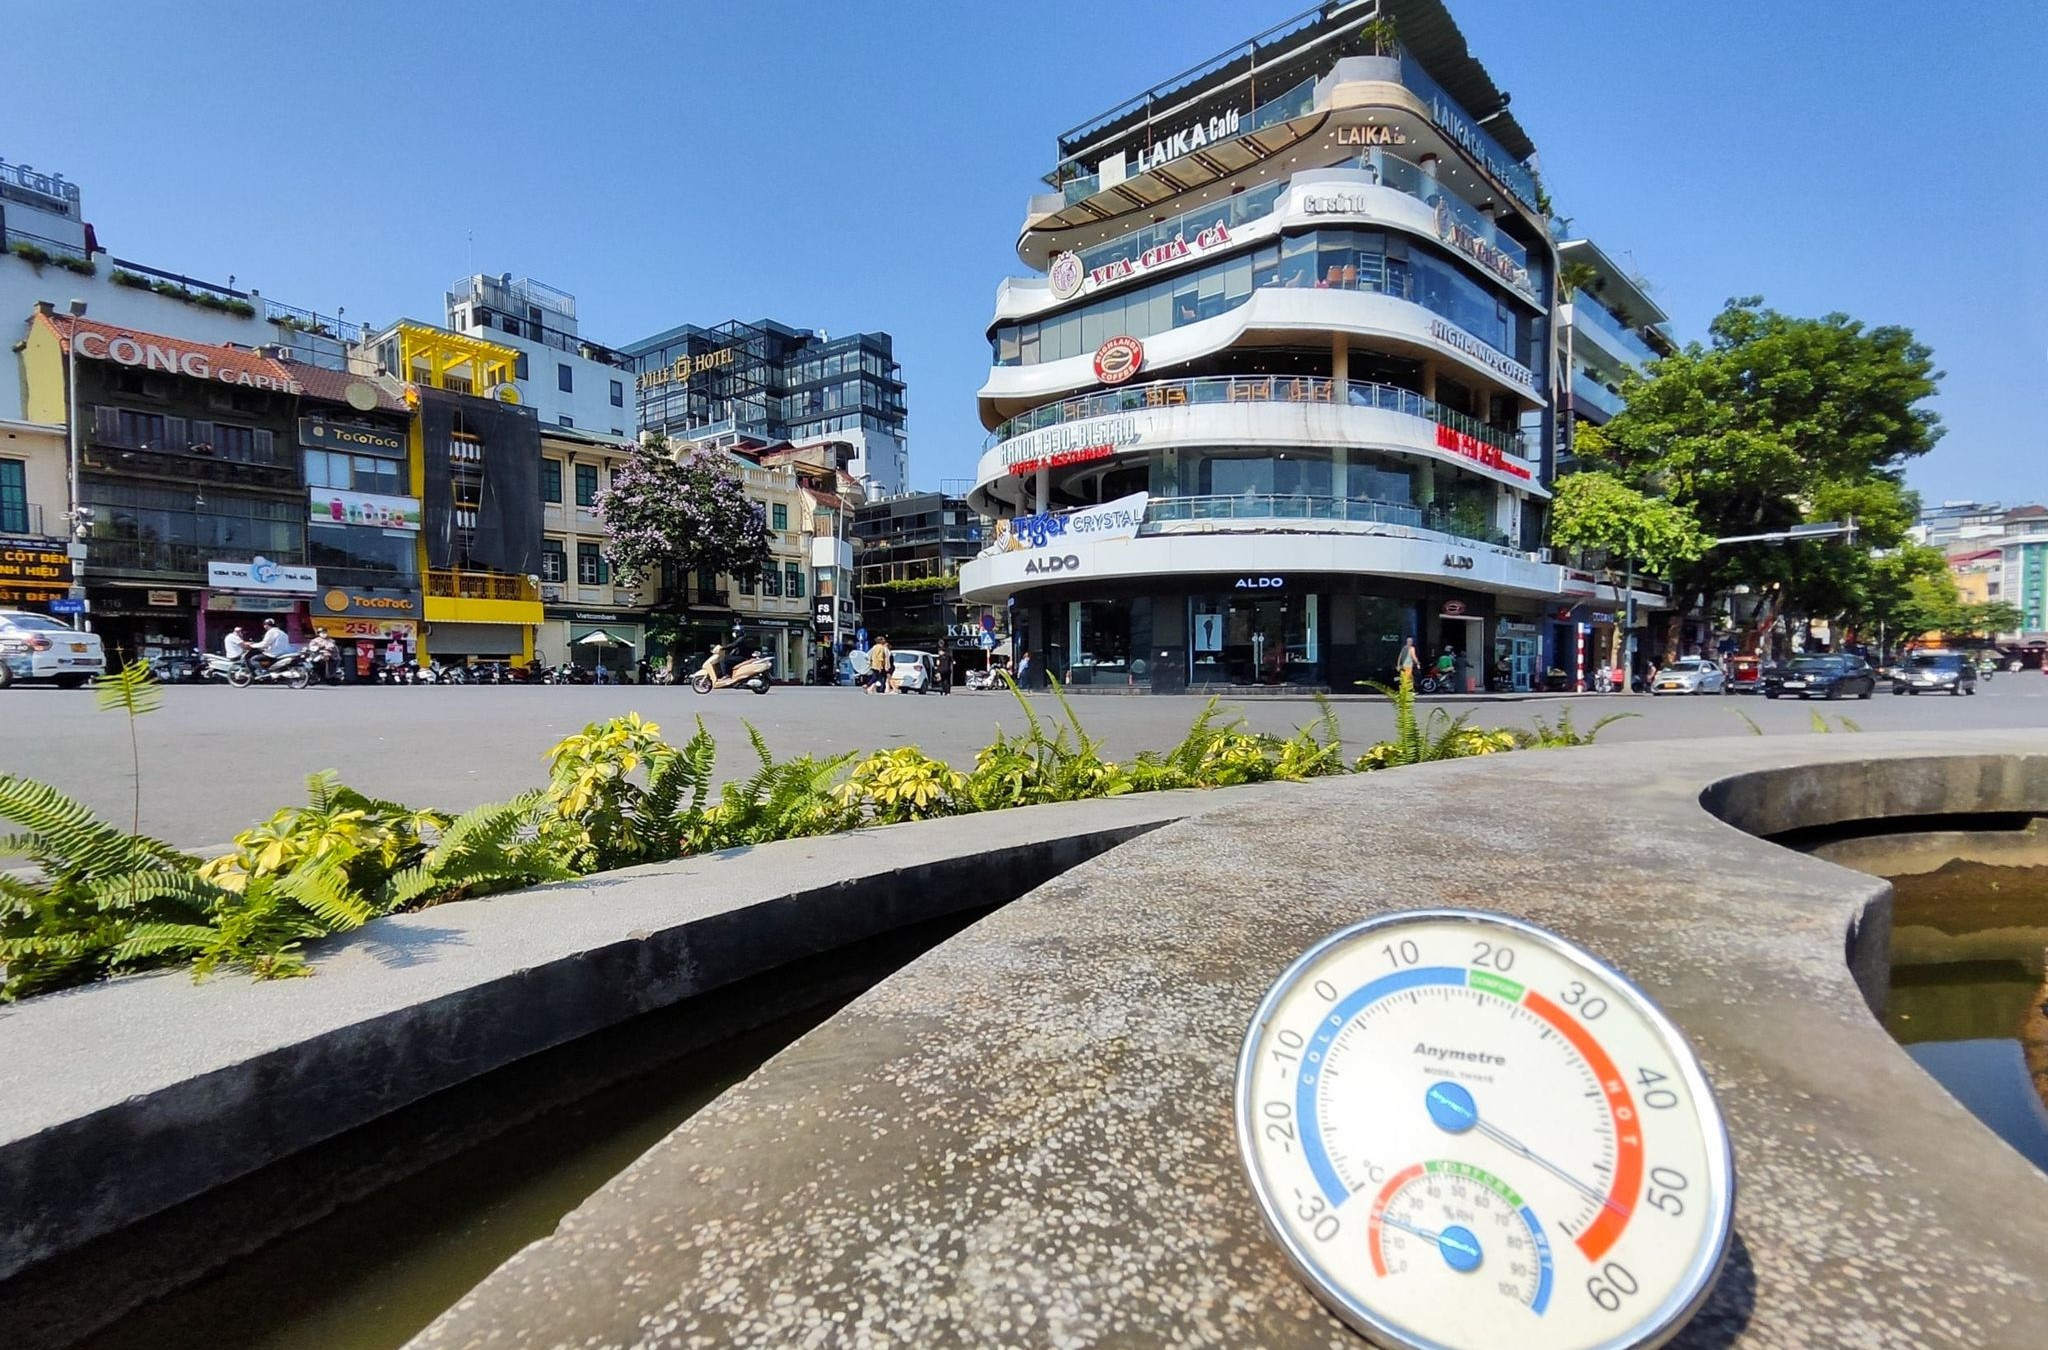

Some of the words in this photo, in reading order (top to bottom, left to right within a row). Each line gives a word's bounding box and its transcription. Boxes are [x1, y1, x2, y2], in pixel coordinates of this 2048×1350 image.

[1337, 126, 1392, 145] LAIKA
[1434, 95, 1471, 152] LAIKA
[1138, 123, 1207, 173] LAIKA
[1209, 107, 1240, 142] Café
[1090, 257, 1134, 284] VUA
[695, 347, 734, 373] HOTEL
[1096, 338, 1139, 363] HIGHLANDS
[1431, 319, 1499, 370] HIGHLANDS
[1499, 359, 1534, 386] COFFEE
[1100, 365, 1134, 381] COFFEE
[1000, 434, 1037, 465] HANOI
[1037, 427, 1072, 453] 1930
[1078, 416, 1136, 447] BISTRO
[1013, 511, 1070, 549] Tiger
[1072, 508, 1142, 533] CRYSTAL
[1024, 554, 1080, 574] ALDO
[1443, 553, 1474, 570] ALDO
[1235, 577, 1283, 588] ALDO
[576, 612, 617, 621] Vietcombank
[816, 614, 834, 624] SPA
[818, 604, 830, 613] FS
[1381, 939, 1419, 968] 10
[1471, 941, 1515, 972] 20
[1314, 979, 1338, 1002] 0
[1560, 981, 1608, 1021] 30
[1271, 1029, 1304, 1079] -10
[1302, 1014, 1342, 1085] COLD
[1413, 1041, 1506, 1067] Anymetre
[1637, 1067, 1679, 1110] 40
[1606, 1079, 1638, 1147] HOT
[1263, 1101, 1295, 1153] -20
[1427, 1185, 1441, 1198] 40
[1452, 1185, 1466, 1198] 50
[1646, 1167, 1689, 1217] 50
[1294, 1187, 1340, 1242] -30
[1507, 1235, 1523, 1249] 80
[1510, 1261, 1527, 1277] 90
[1586, 1262, 1639, 1312] 60
